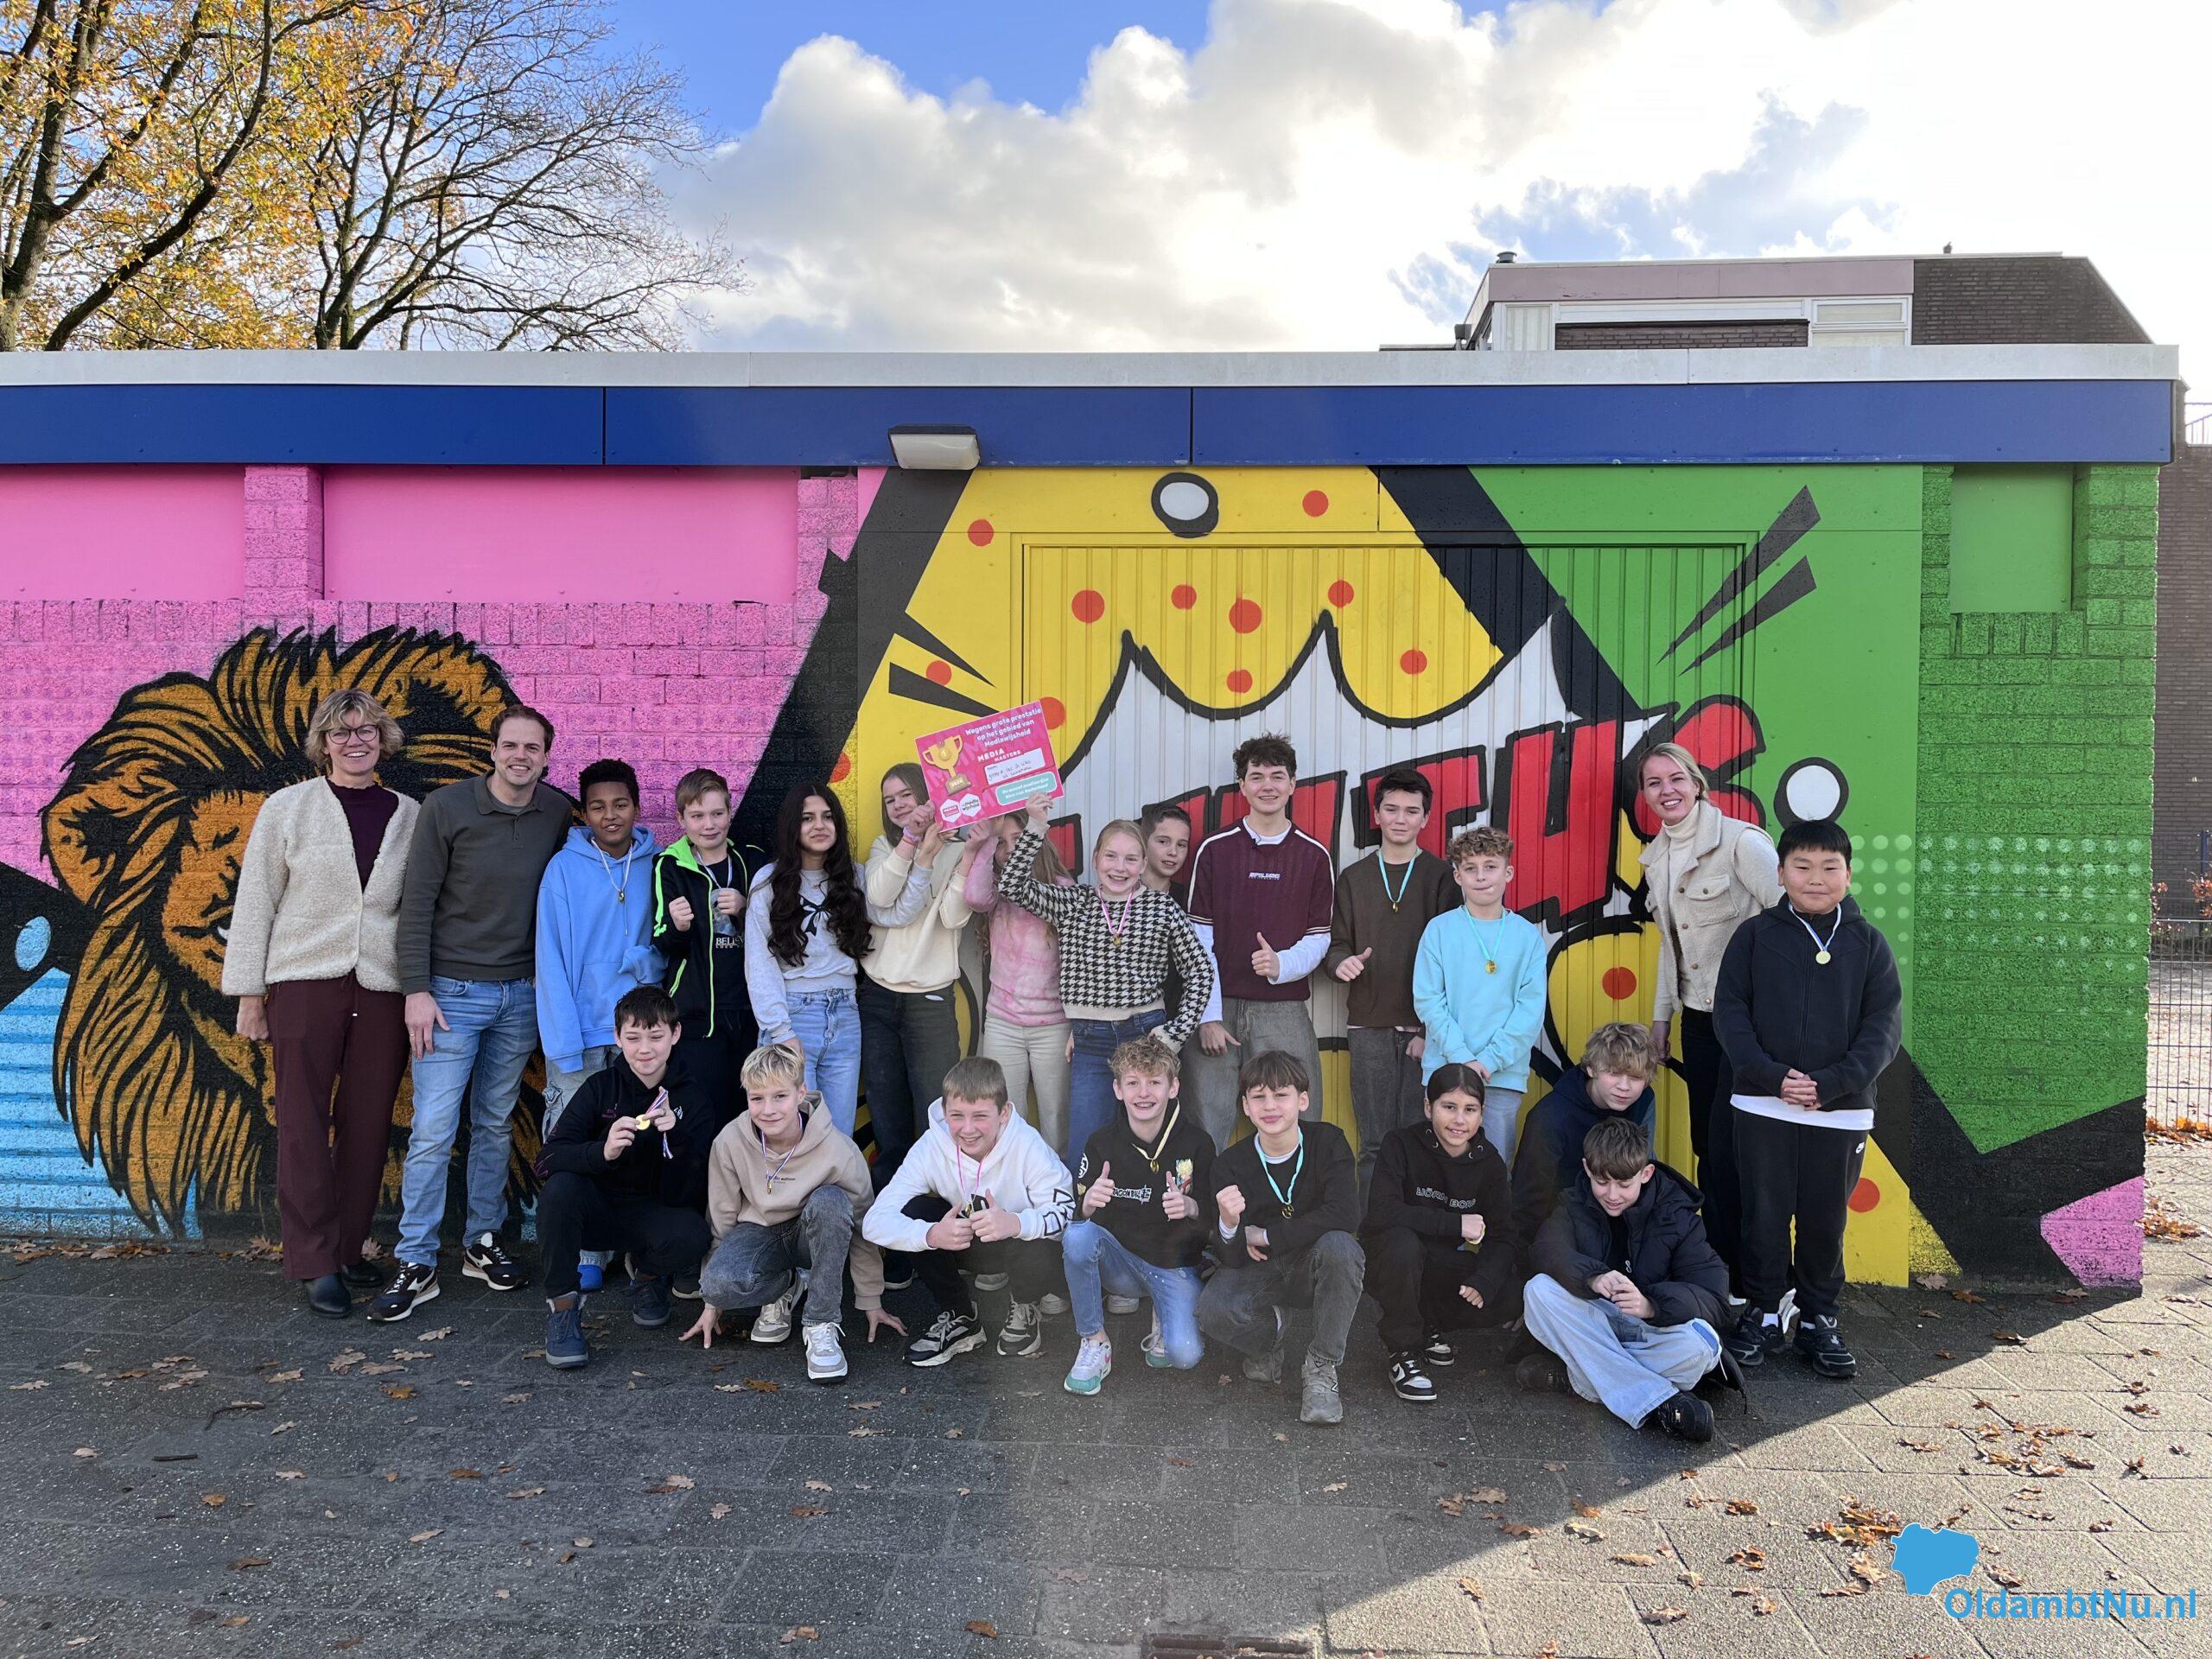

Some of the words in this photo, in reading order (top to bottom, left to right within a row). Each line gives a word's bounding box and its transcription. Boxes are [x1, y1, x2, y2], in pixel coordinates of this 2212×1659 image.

[965, 724, 991, 736] Wegens
[991, 717, 1010, 729] grote
[1010, 708, 1042, 722] prestatie
[987, 729, 998, 739] het
[999, 722, 1021, 736] gebied
[1021, 719, 1034, 728] van
[984, 728, 1031, 747] Mediawijsheid
[977, 747, 1005, 762] MEDIA
[994, 750, 1021, 762] MASTERS
